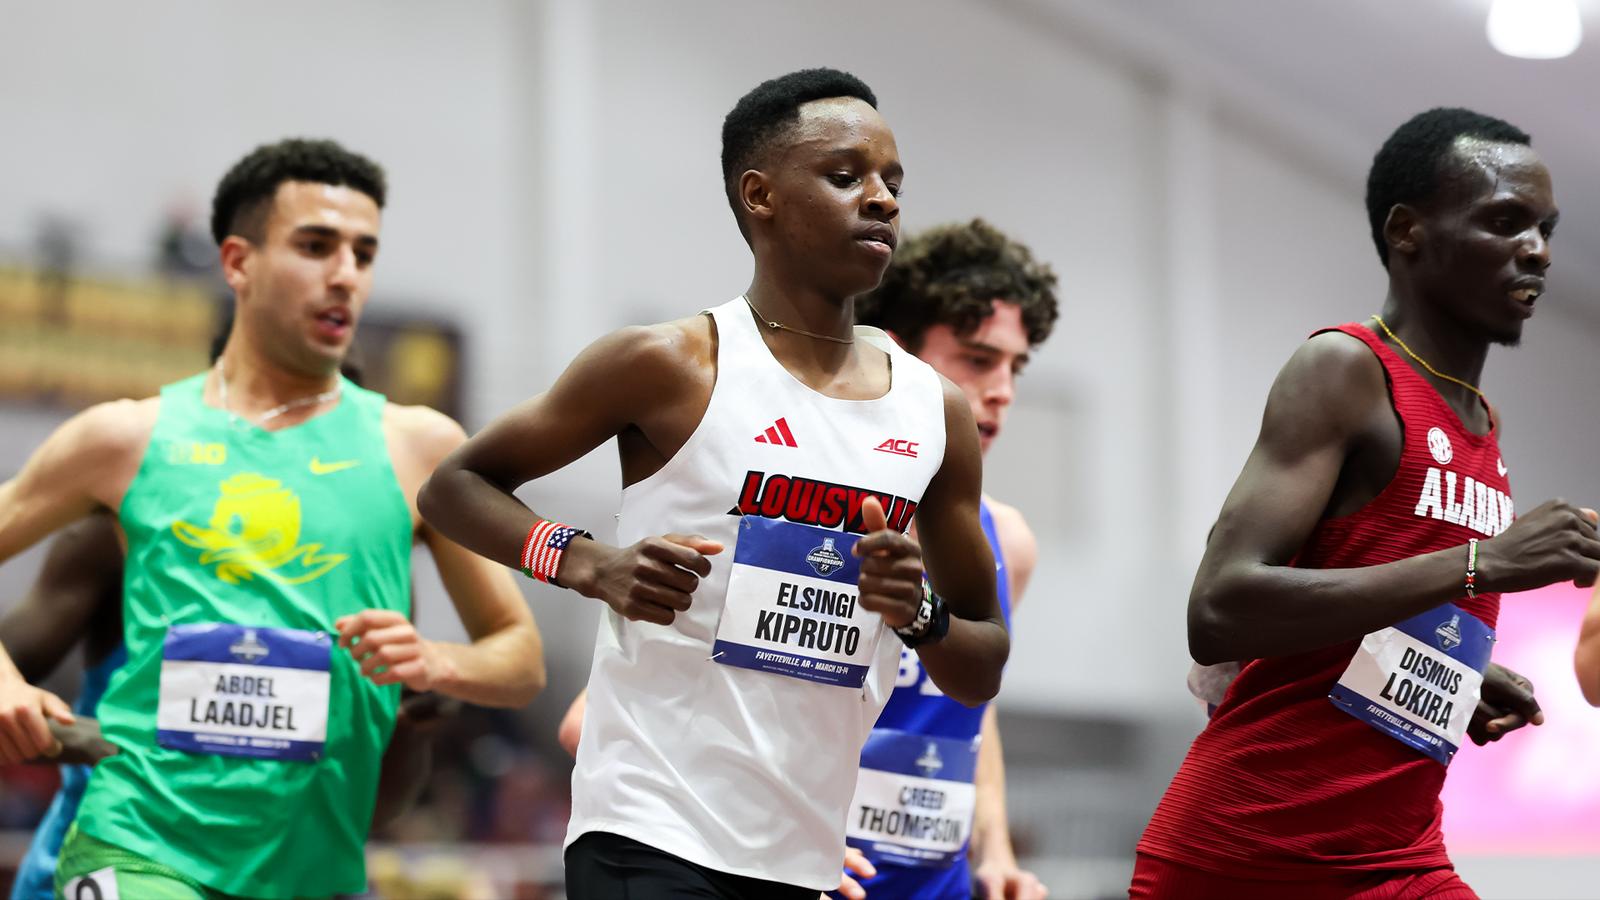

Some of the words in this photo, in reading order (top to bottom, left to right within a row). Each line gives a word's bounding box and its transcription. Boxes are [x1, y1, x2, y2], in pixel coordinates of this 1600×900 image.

[875, 438, 920, 457] ACC
[1414, 467, 1514, 537] ALABAM
[776, 582, 857, 619] ELSINGI
[754, 610, 860, 656] KIPRUTO
[755, 651, 800, 666] FAYETTEVILLE,
[800, 659, 812, 669] AR
[815, 661, 836, 673] MARCH
[1399, 646, 1463, 696] DISMUS
[215, 674, 278, 698] ABDEL
[1380, 672, 1455, 730] LOKIRA
[190, 698, 297, 732] LAADJEL
[900, 786, 947, 811] CREED
[859, 805, 963, 843] THOMPSON
